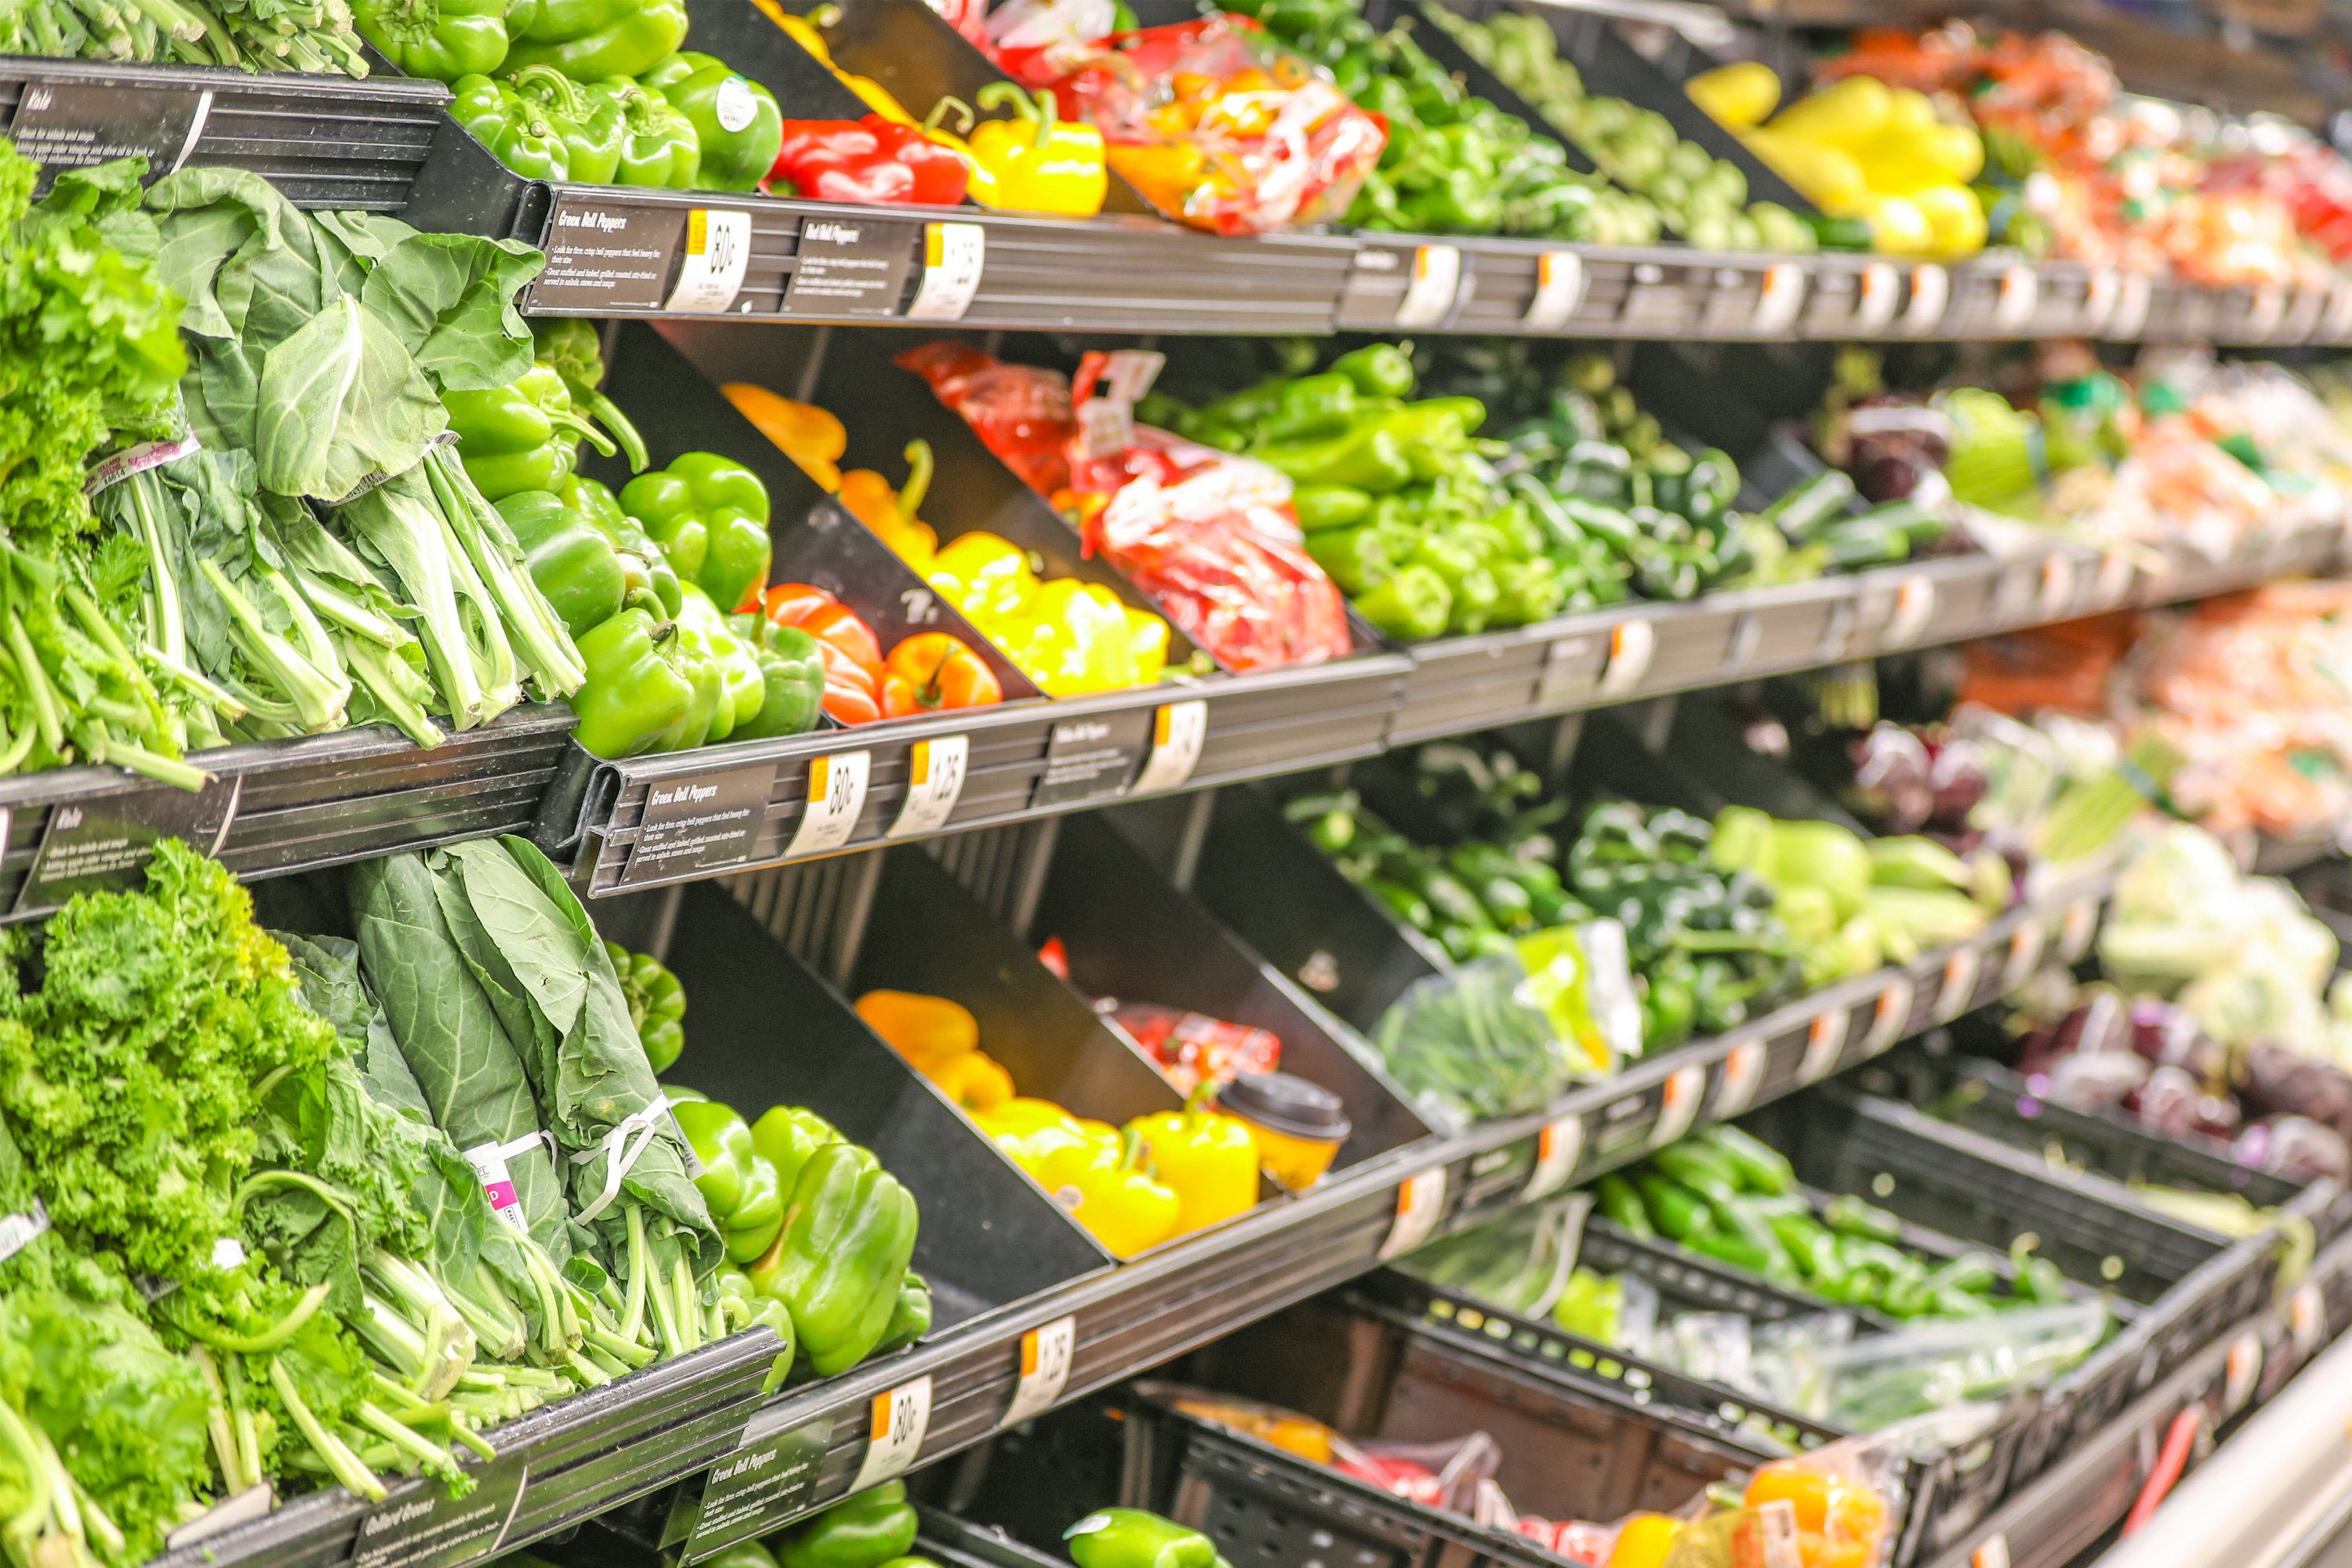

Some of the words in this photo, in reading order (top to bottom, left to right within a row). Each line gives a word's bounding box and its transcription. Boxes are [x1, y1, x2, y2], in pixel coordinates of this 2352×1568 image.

[559, 210, 580, 227] Green
[581, 212, 597, 227] Bell
[597, 212, 626, 233] Peppers
[652, 790, 672, 806] Green
[673, 786, 690, 803] Bell
[688, 784, 718, 803] Peppers
[712, 1465, 734, 1485] Green
[733, 1456, 750, 1475] Bell
[748, 1449, 778, 1471] Peppers
